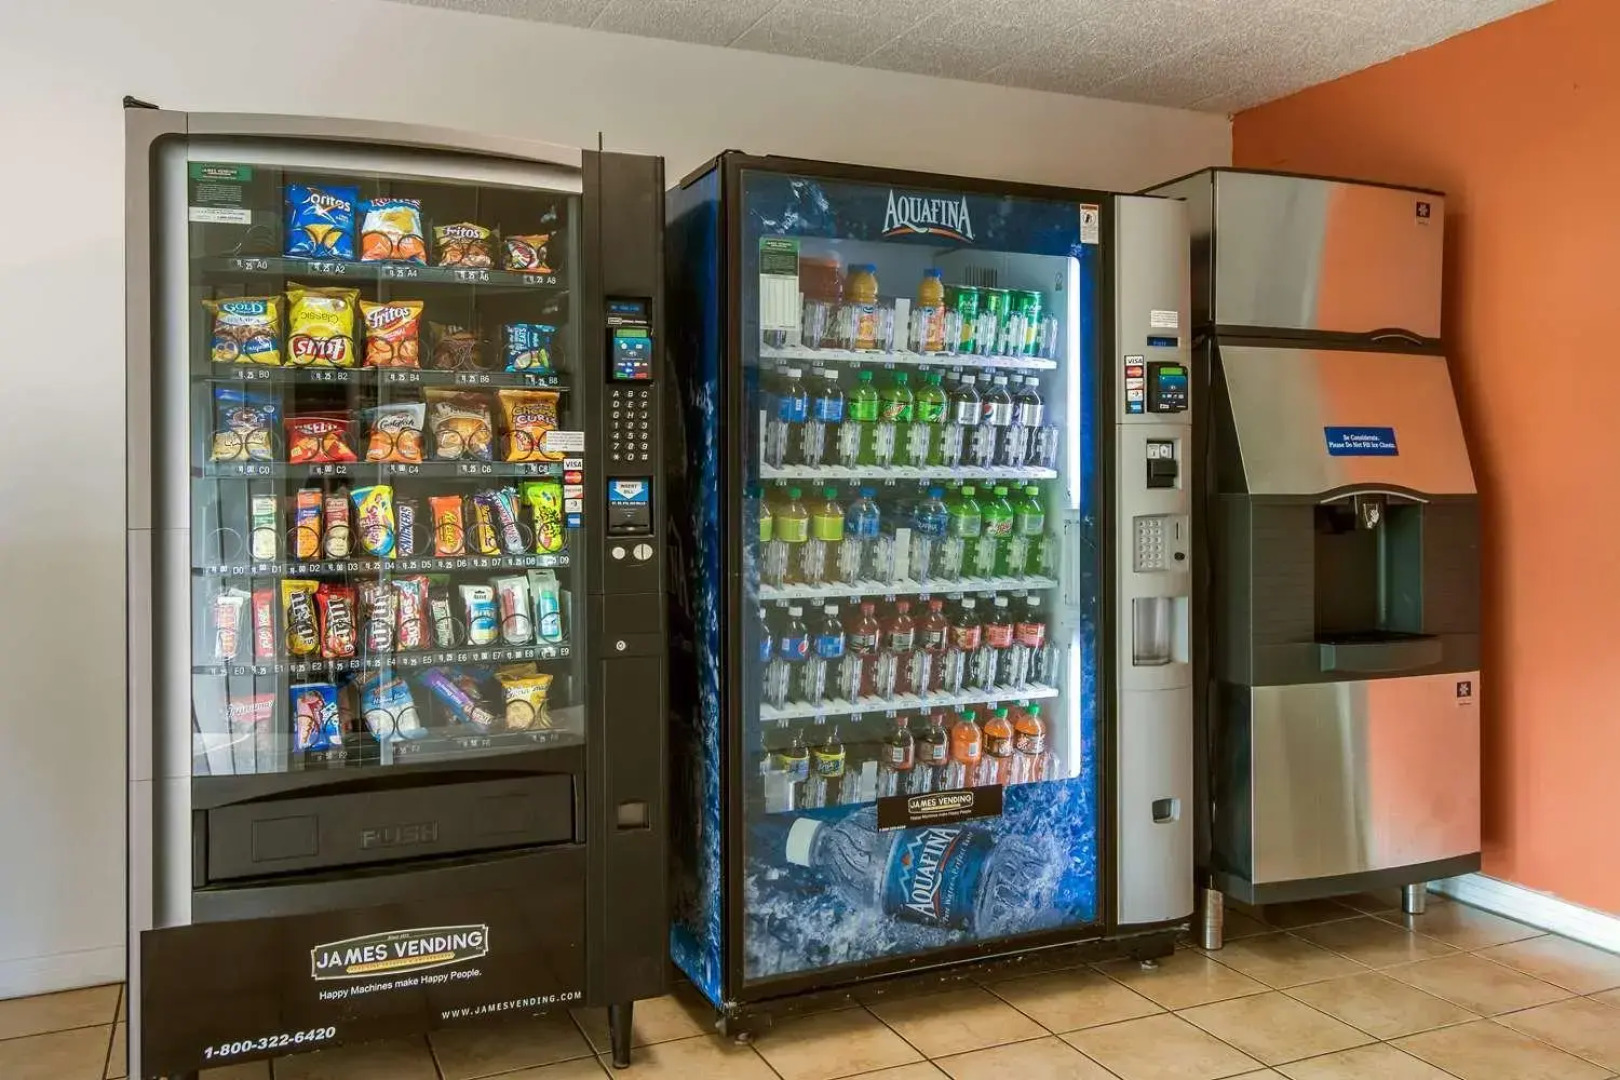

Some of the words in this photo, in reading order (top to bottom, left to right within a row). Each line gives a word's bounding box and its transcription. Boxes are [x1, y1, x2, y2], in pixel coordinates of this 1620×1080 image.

[881, 189, 974, 240] AQUAFINA
[407, 268, 418, 278] A4
[223, 303, 264, 314] GOLD
[366, 306, 411, 329] Fritos
[613, 390, 620, 398] A
[627, 390, 634, 398] B
[641, 391, 648, 399] C
[641, 401, 648, 409] F
[613, 411, 620, 419] G
[627, 411, 635, 419] H
[641, 411, 648, 419] J
[613, 432, 620, 440] 4
[627, 432, 634, 440] 5
[641, 432, 648, 440] 6
[336, 465, 347, 475] C2
[399, 505, 414, 554] SNICKERS
[347, 562, 359, 571] D3
[421, 560, 432, 569] D5
[456, 559, 468, 568] D6
[491, 557, 502, 567] D7
[309, 564, 321, 573] D2
[422, 656, 433, 664] E5
[458, 653, 468, 662] E6
[492, 651, 502, 660] E7
[311, 662, 323, 671] E2
[910, 798, 937, 809] JAMES
[938, 794, 972, 806] VENDING
[363, 821, 438, 849] PUSH
[905, 827, 961, 919] AQUAFINA
[316, 944, 388, 969] JAMES
[394, 931, 484, 958] VENDING
[319, 986, 349, 1001] Happy
[350, 980, 393, 996] Machines
[395, 976, 419, 988] make
[421, 972, 448, 985] Happy
[450, 968, 483, 982] People.
[441, 990, 583, 1020] WWW.JAMESVENDING.COM
[204, 1026, 337, 1059] 1-800-322-6420
